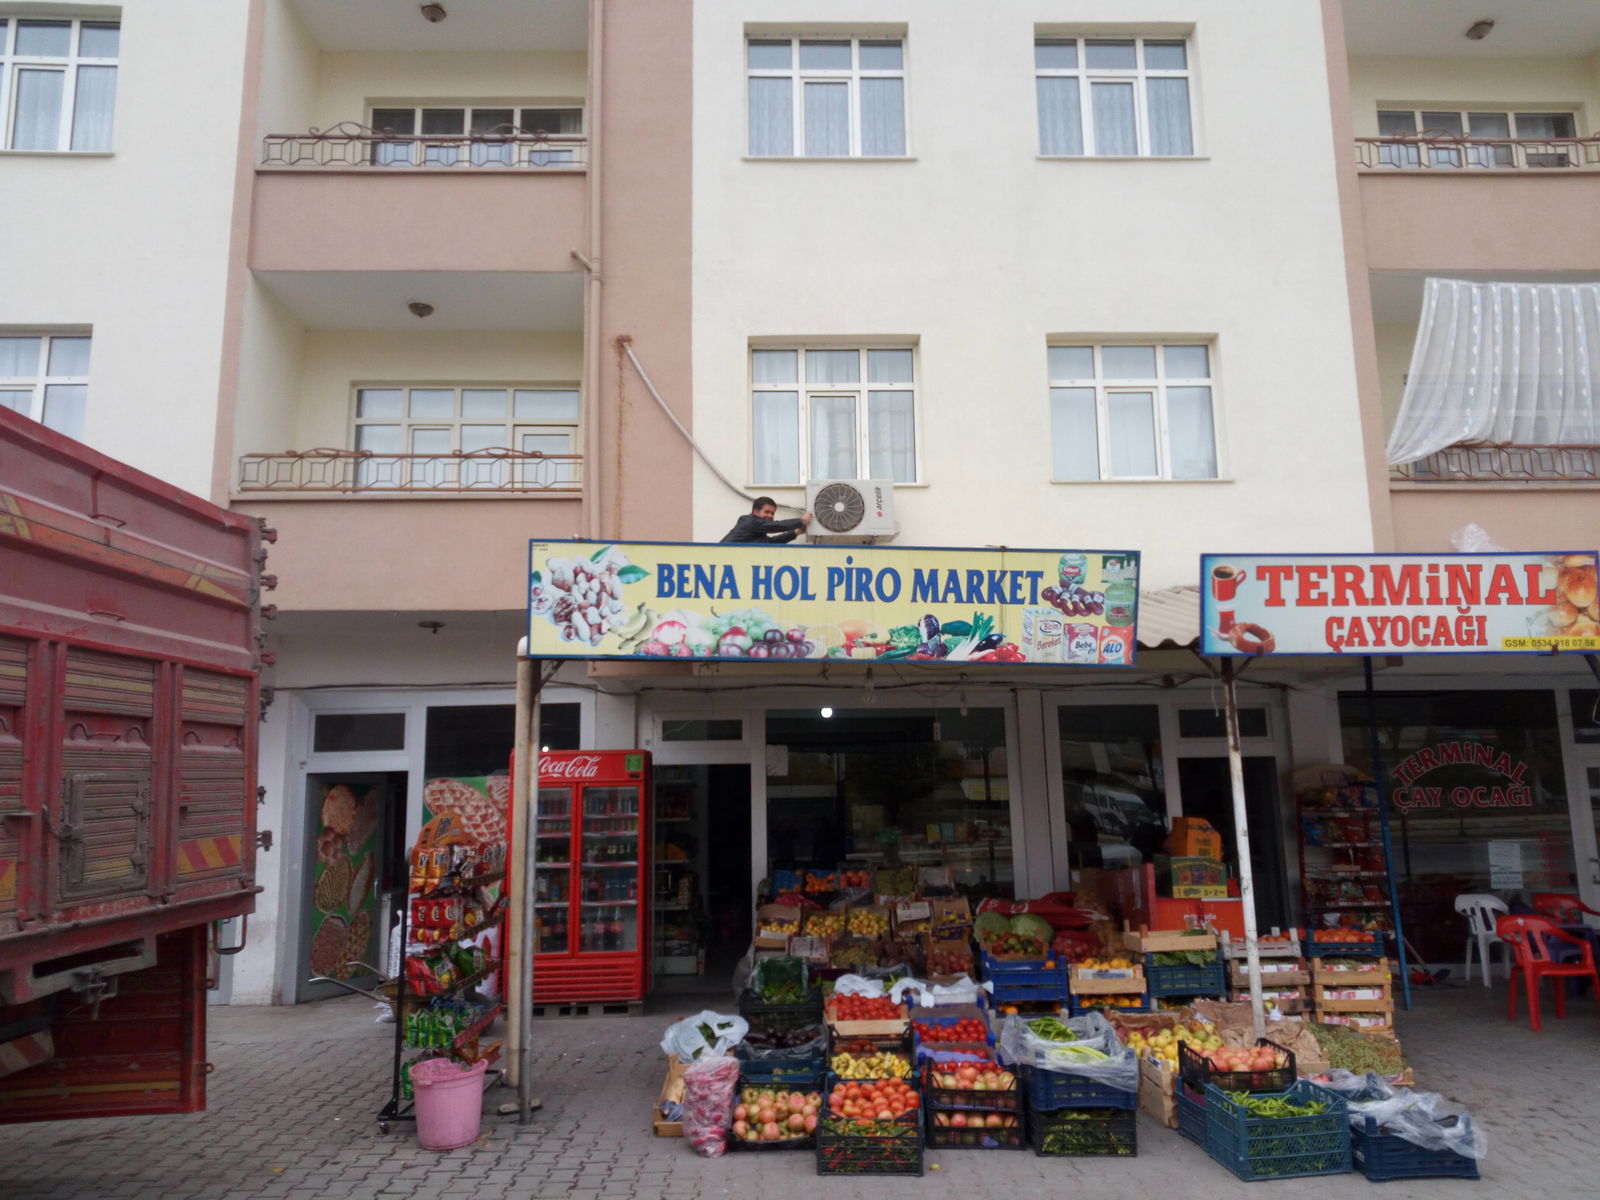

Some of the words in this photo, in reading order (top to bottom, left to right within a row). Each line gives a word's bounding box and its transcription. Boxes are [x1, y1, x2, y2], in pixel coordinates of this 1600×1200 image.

[656, 563, 741, 600] BENA
[751, 565, 817, 601] HOL
[911, 568, 1044, 605] MARKET
[1325, 606, 1488, 653] ÇAYOCAĞI
[1505, 639, 1529, 648] GSM:
[1103, 641, 1123, 653] ALO
[1392, 786, 1442, 815] ÇAY
